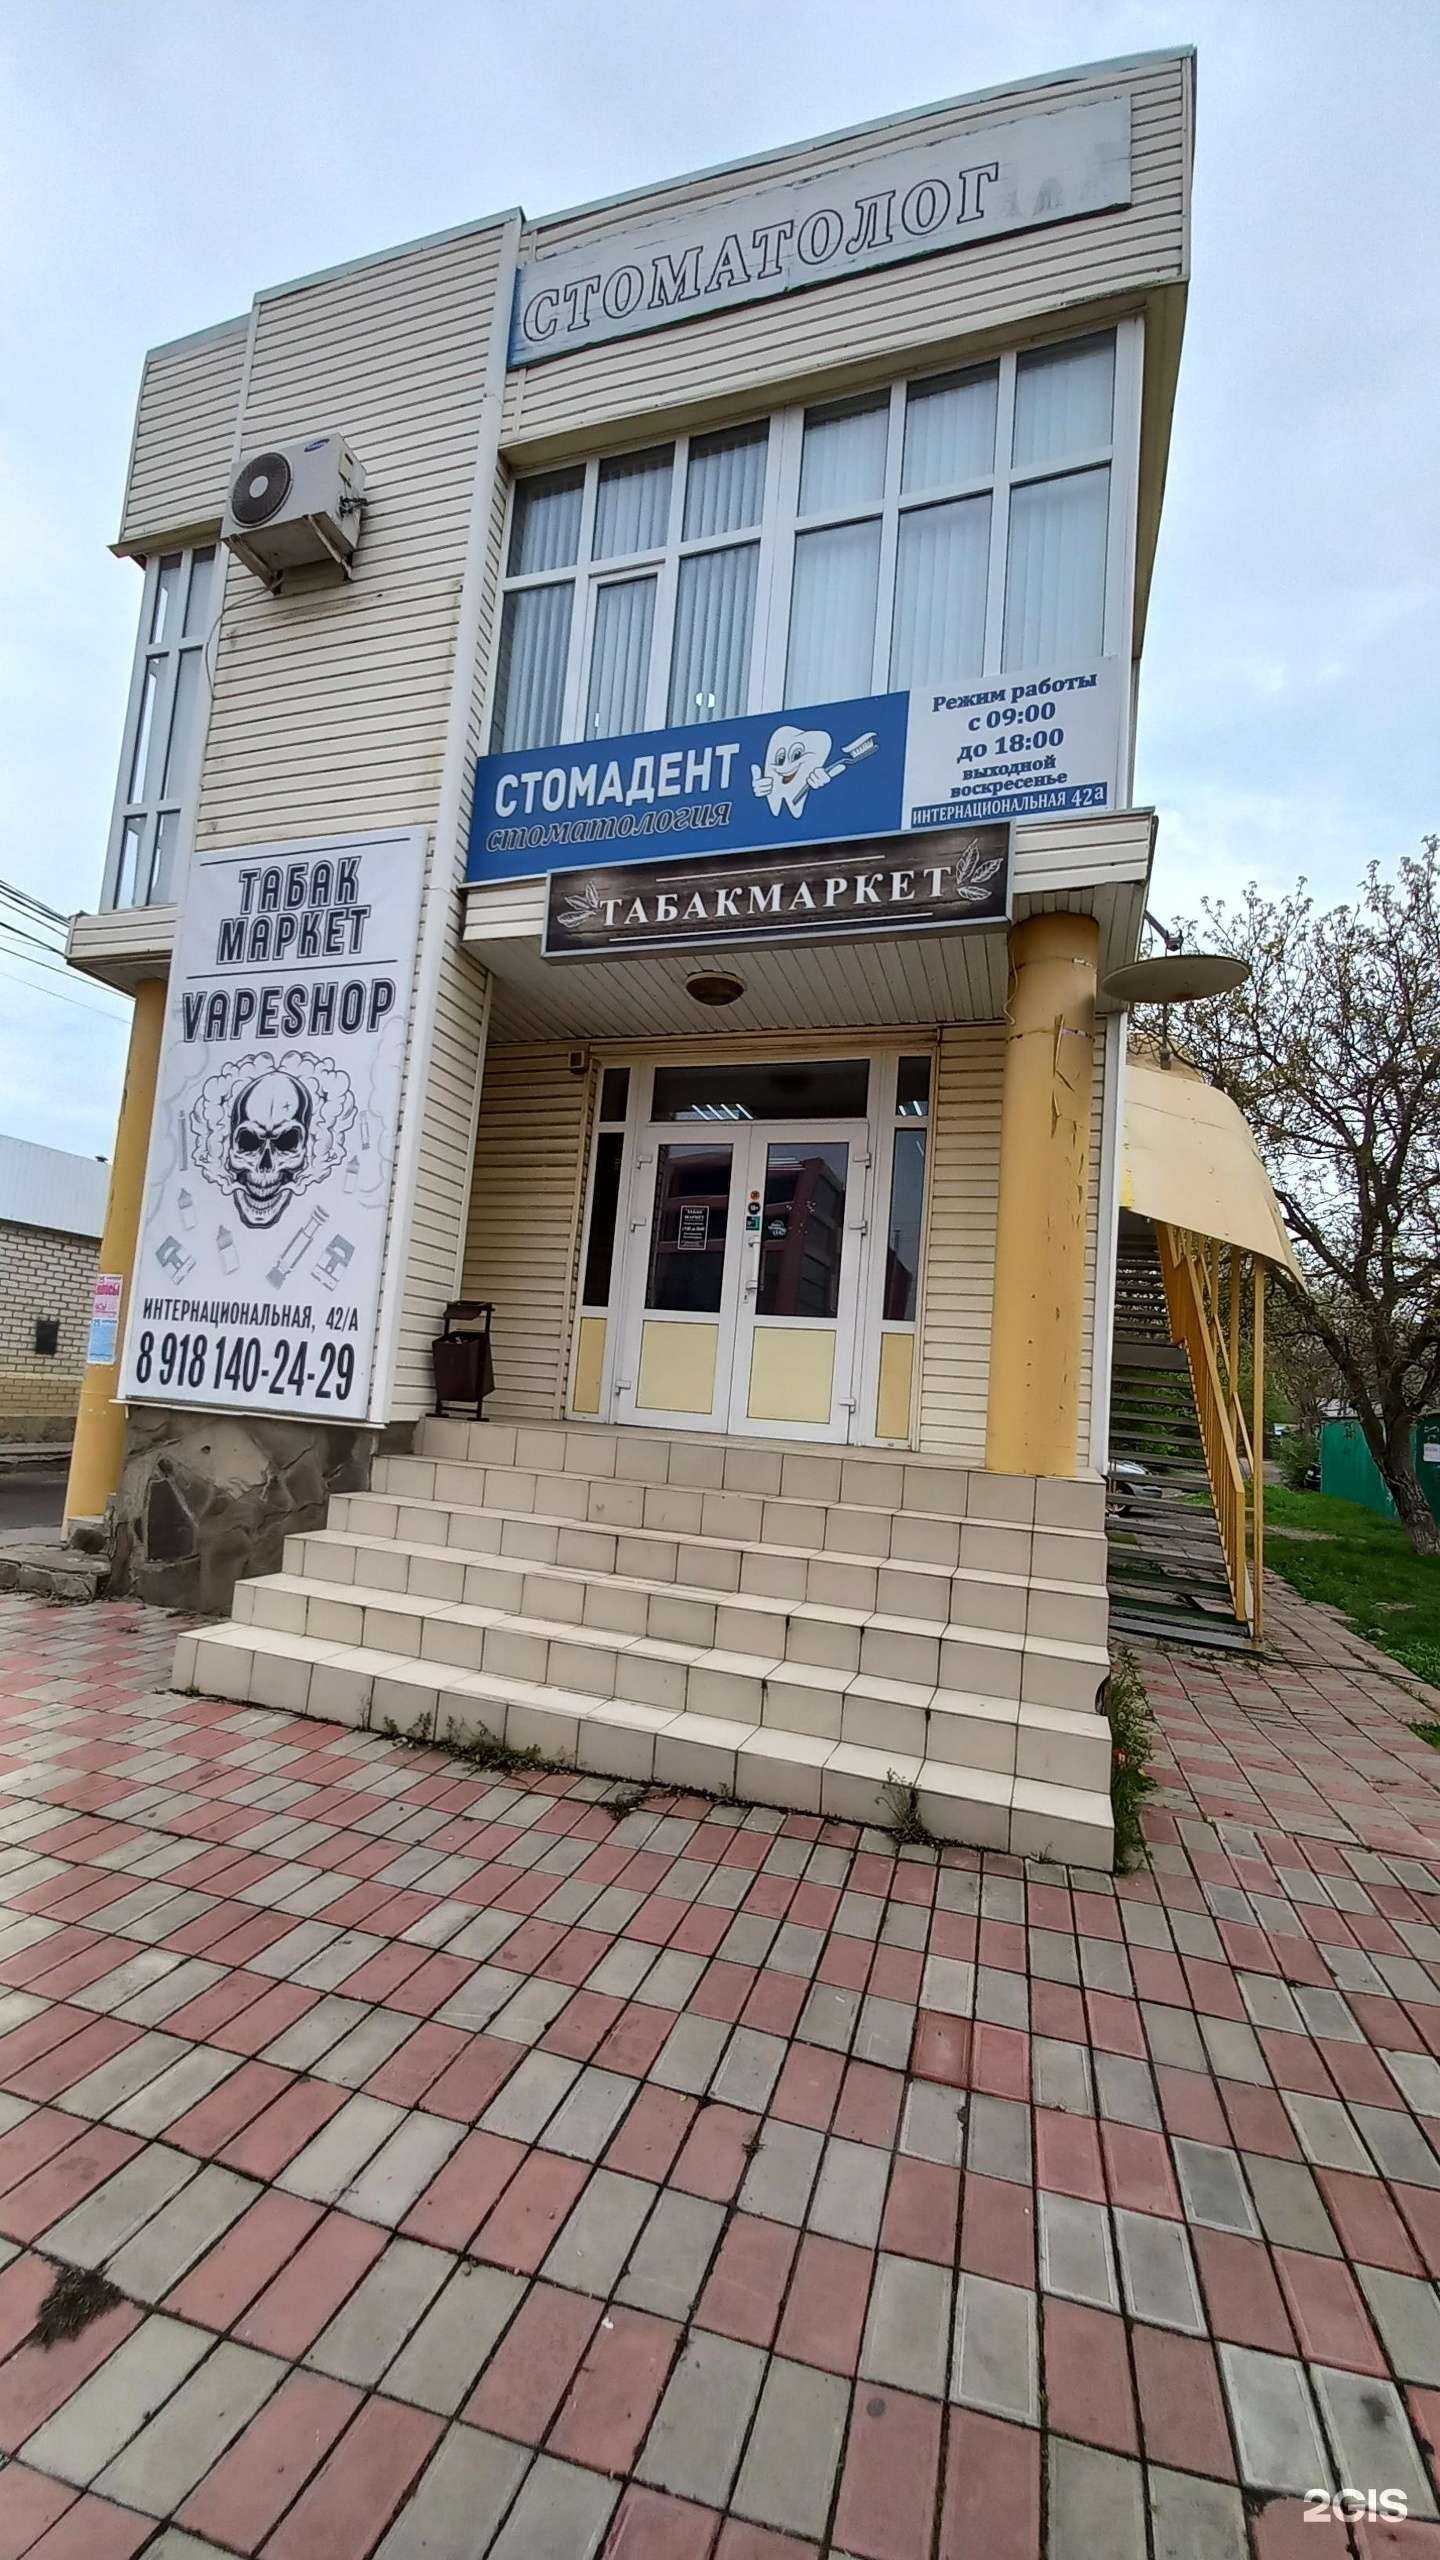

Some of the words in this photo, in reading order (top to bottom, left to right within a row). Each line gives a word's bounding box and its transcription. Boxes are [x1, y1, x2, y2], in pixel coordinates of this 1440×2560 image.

[932, 688, 1005, 712] Режим
[1011, 673, 1098, 703] работы
[968, 717, 980, 731] с
[987, 702, 1056, 729] 09:00
[957, 743, 988, 764] до
[995, 728, 1064, 755] 18:00
[962, 754, 1056, 781] выходной
[495, 743, 740, 817] СТОМАДЕНТ
[950, 772, 1067, 798] воскресенье
[486, 801, 732, 852] стоматология
[913, 792, 1066, 825] ИНТЕРНАЦИОНАЛЬНАЯ
[1071, 786, 1105, 807] 42а
[238, 855, 362, 915] ТАБАК
[600, 866, 952, 926] ТАБАКМАРКЕТ
[216, 905, 371, 965] МАРКЕТ
[182, 978, 396, 1043] VAPESHOP
[143, 1298, 316, 1334] ИНТЕРНАЦИОНАЛЬНАЯ,
[325, 1306, 359, 1331] 42/А
[136, 1331, 154, 1383] 8
[159, 1332, 208, 1388] 918
[213, 1336, 355, 1400] 140-24-29
